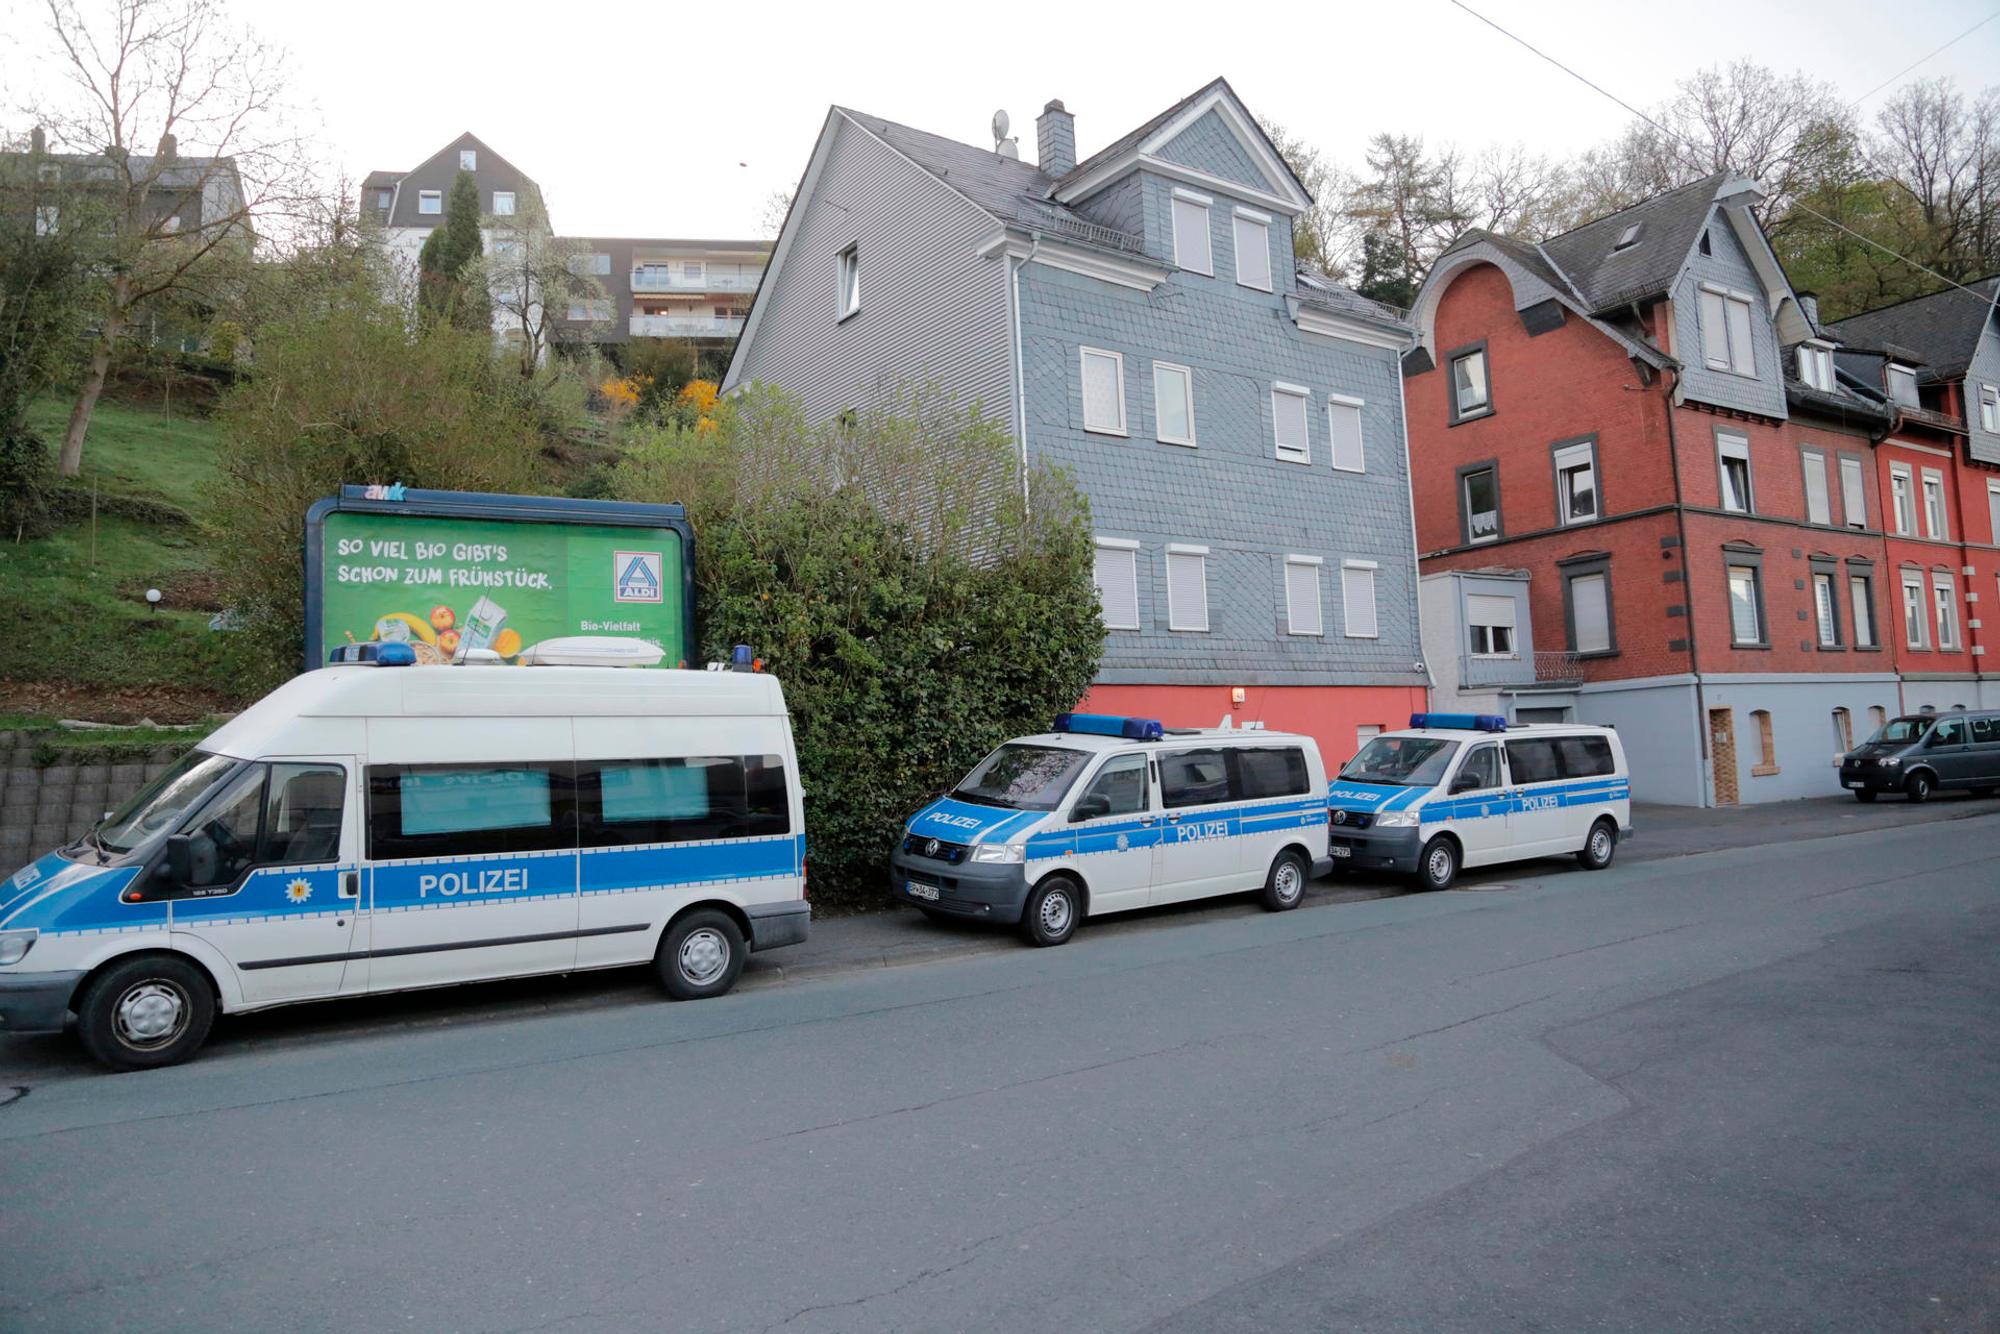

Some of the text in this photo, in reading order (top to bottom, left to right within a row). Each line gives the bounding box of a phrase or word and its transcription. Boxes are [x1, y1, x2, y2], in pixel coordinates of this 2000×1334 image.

[338, 539, 508, 562] SO VIEL BIO GIBT'S
[338, 565, 552, 590] SCHON ZUM FRÜHSTÜCK.
[623, 586, 656, 598] ALDI
[581, 621, 640, 631] Bio-Vielfalt
[1329, 790, 1381, 802] POLIZEI
[1523, 796, 1558, 811] POLIZEI
[926, 812, 982, 829] POLIZEI
[1177, 821, 1229, 842] POLIZEI
[420, 868, 528, 898] POLIZEI
